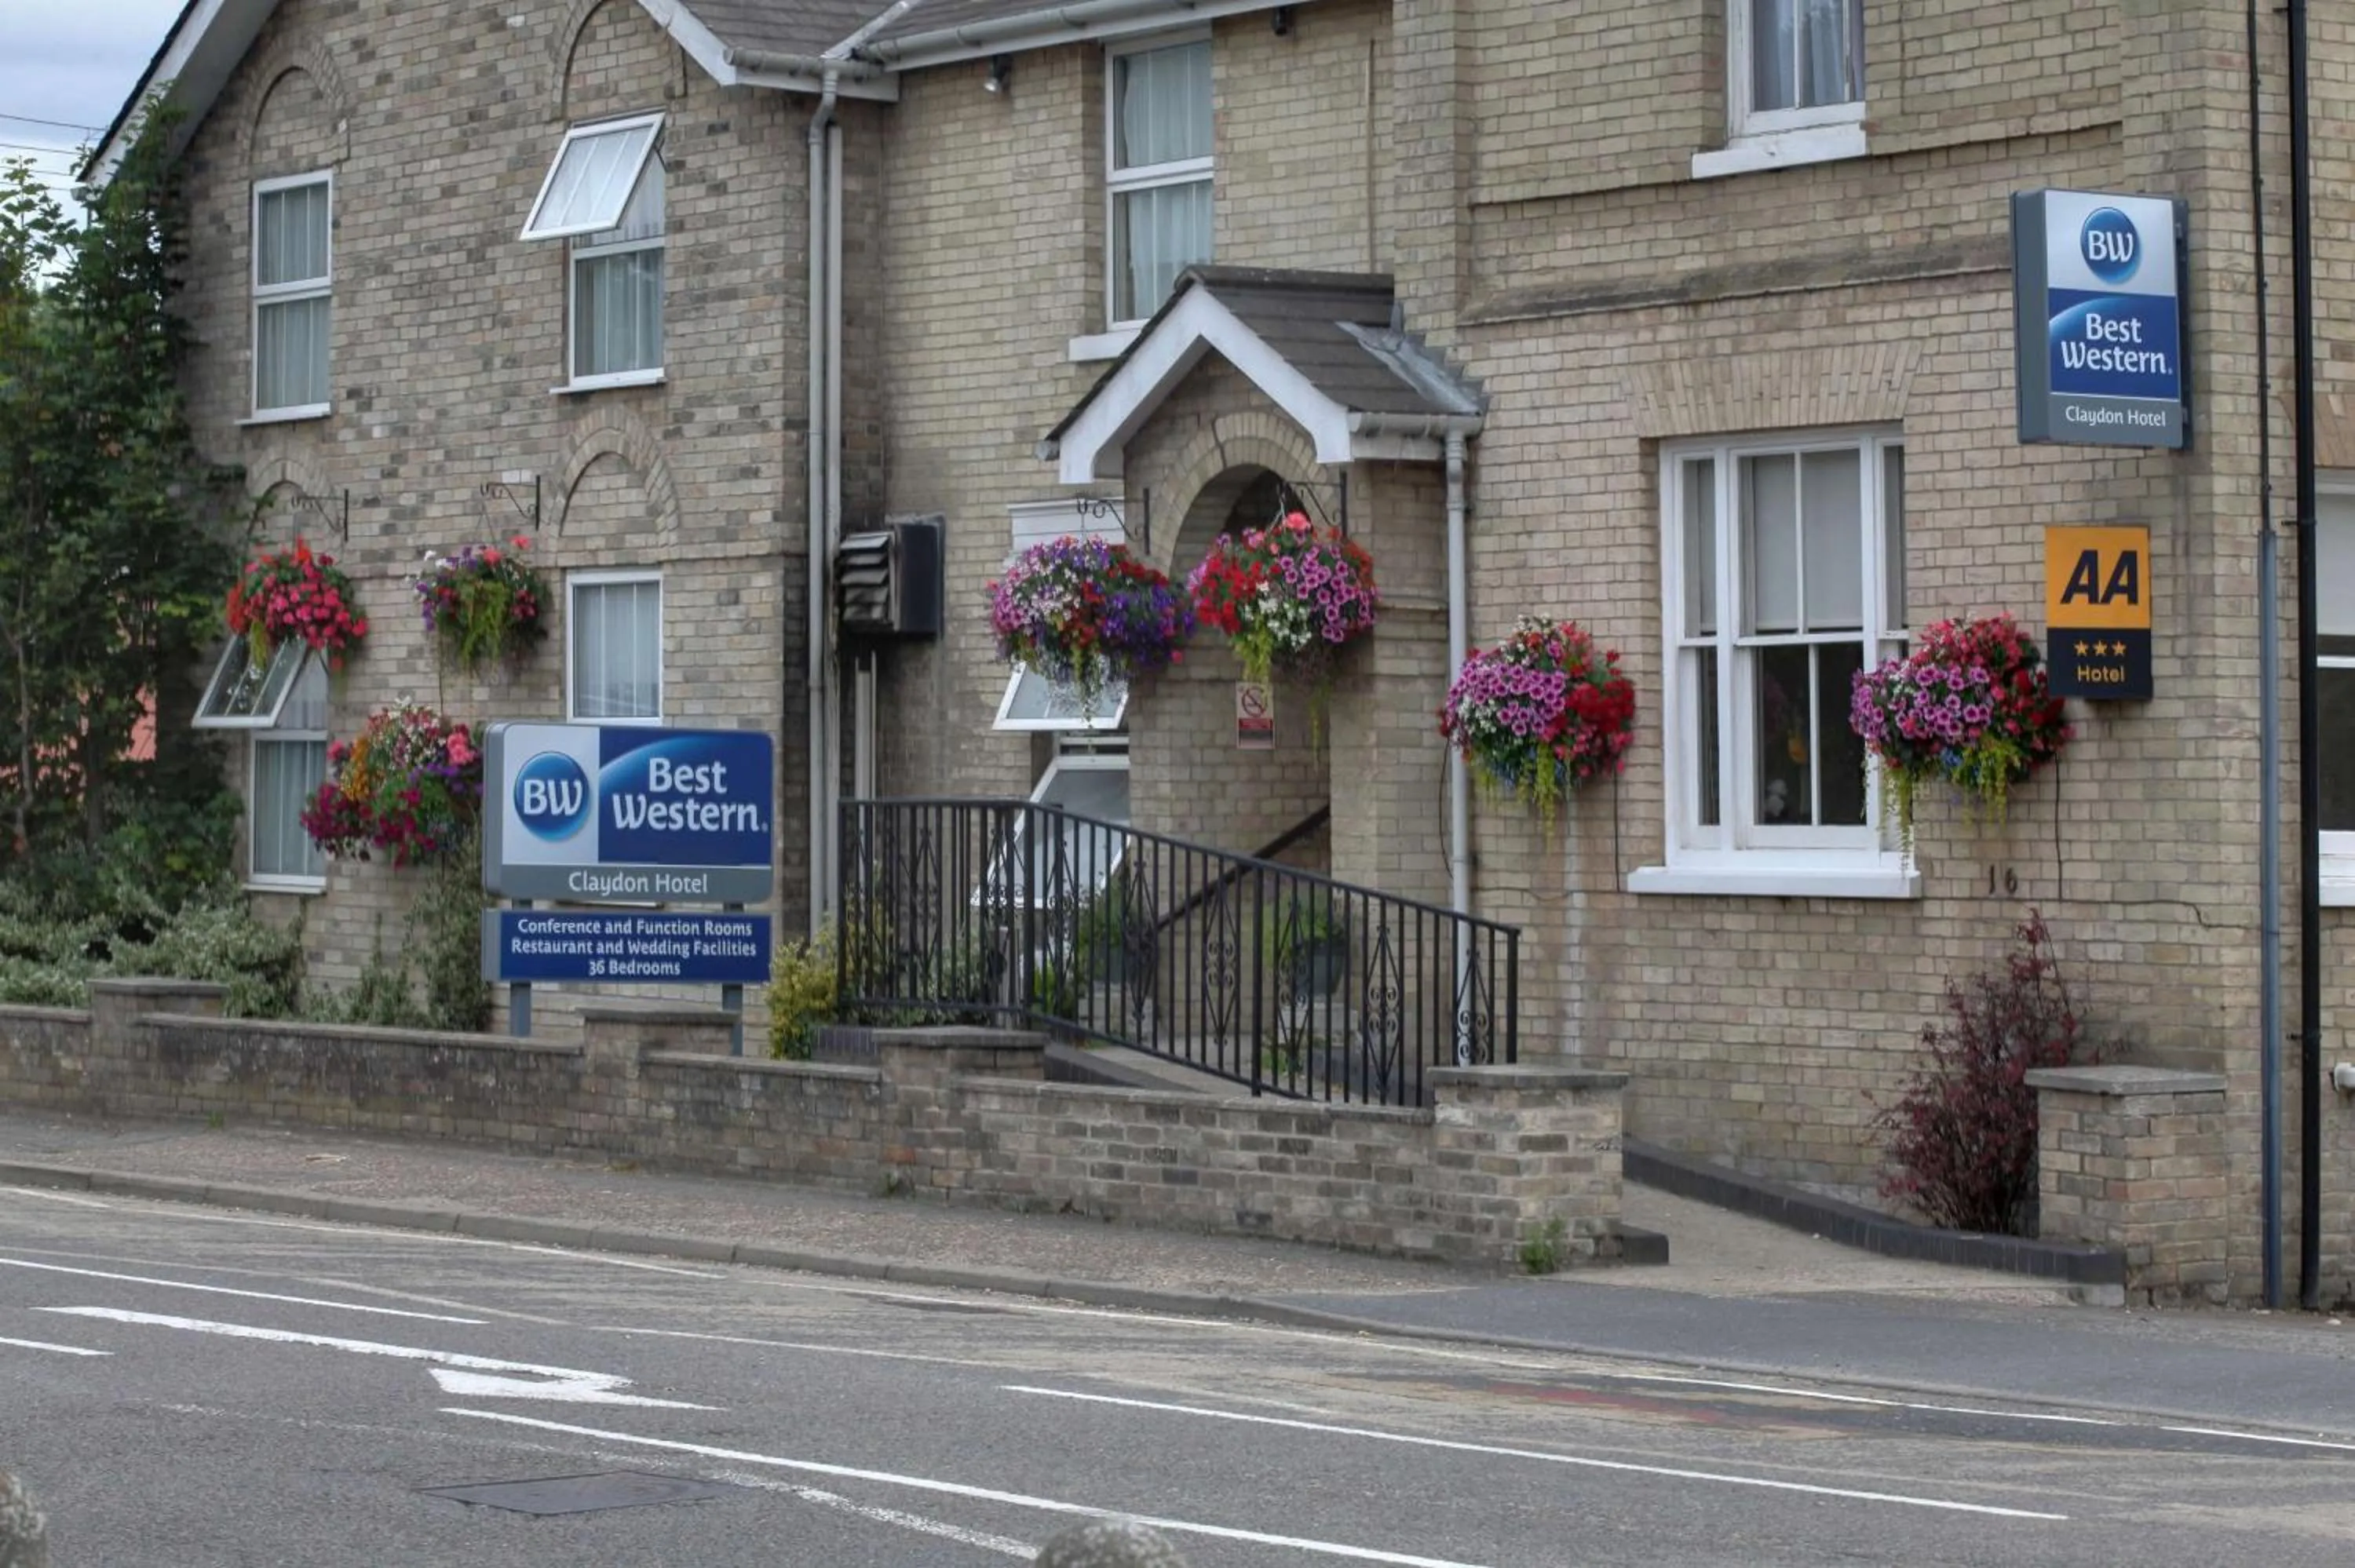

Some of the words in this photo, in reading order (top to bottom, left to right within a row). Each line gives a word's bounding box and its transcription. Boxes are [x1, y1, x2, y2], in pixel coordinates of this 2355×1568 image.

[2088, 231, 2134, 262] BW
[2085, 312, 2142, 344] Best
[2065, 406, 2123, 426] Claydon
[2127, 410, 2167, 427] Hotel
[2060, 549, 2139, 606] AA
[2077, 665, 2126, 683] Hotel
[649, 757, 728, 794] Best
[524, 779, 582, 815] BW
[568, 872, 649, 896] Claydon
[655, 873, 708, 893] Hotel
[517, 919, 601, 934] Conference
[604, 919, 633, 934] and
[637, 919, 700, 935] Function
[705, 921, 753, 936] Rooms
[512, 939, 593, 955] Restaurant
[597, 939, 624, 955] and
[627, 939, 690, 958] Wedding
[693, 941, 757, 957] Facilities
[589, 959, 605, 976] 36
[609, 959, 681, 975] Bedrooms
